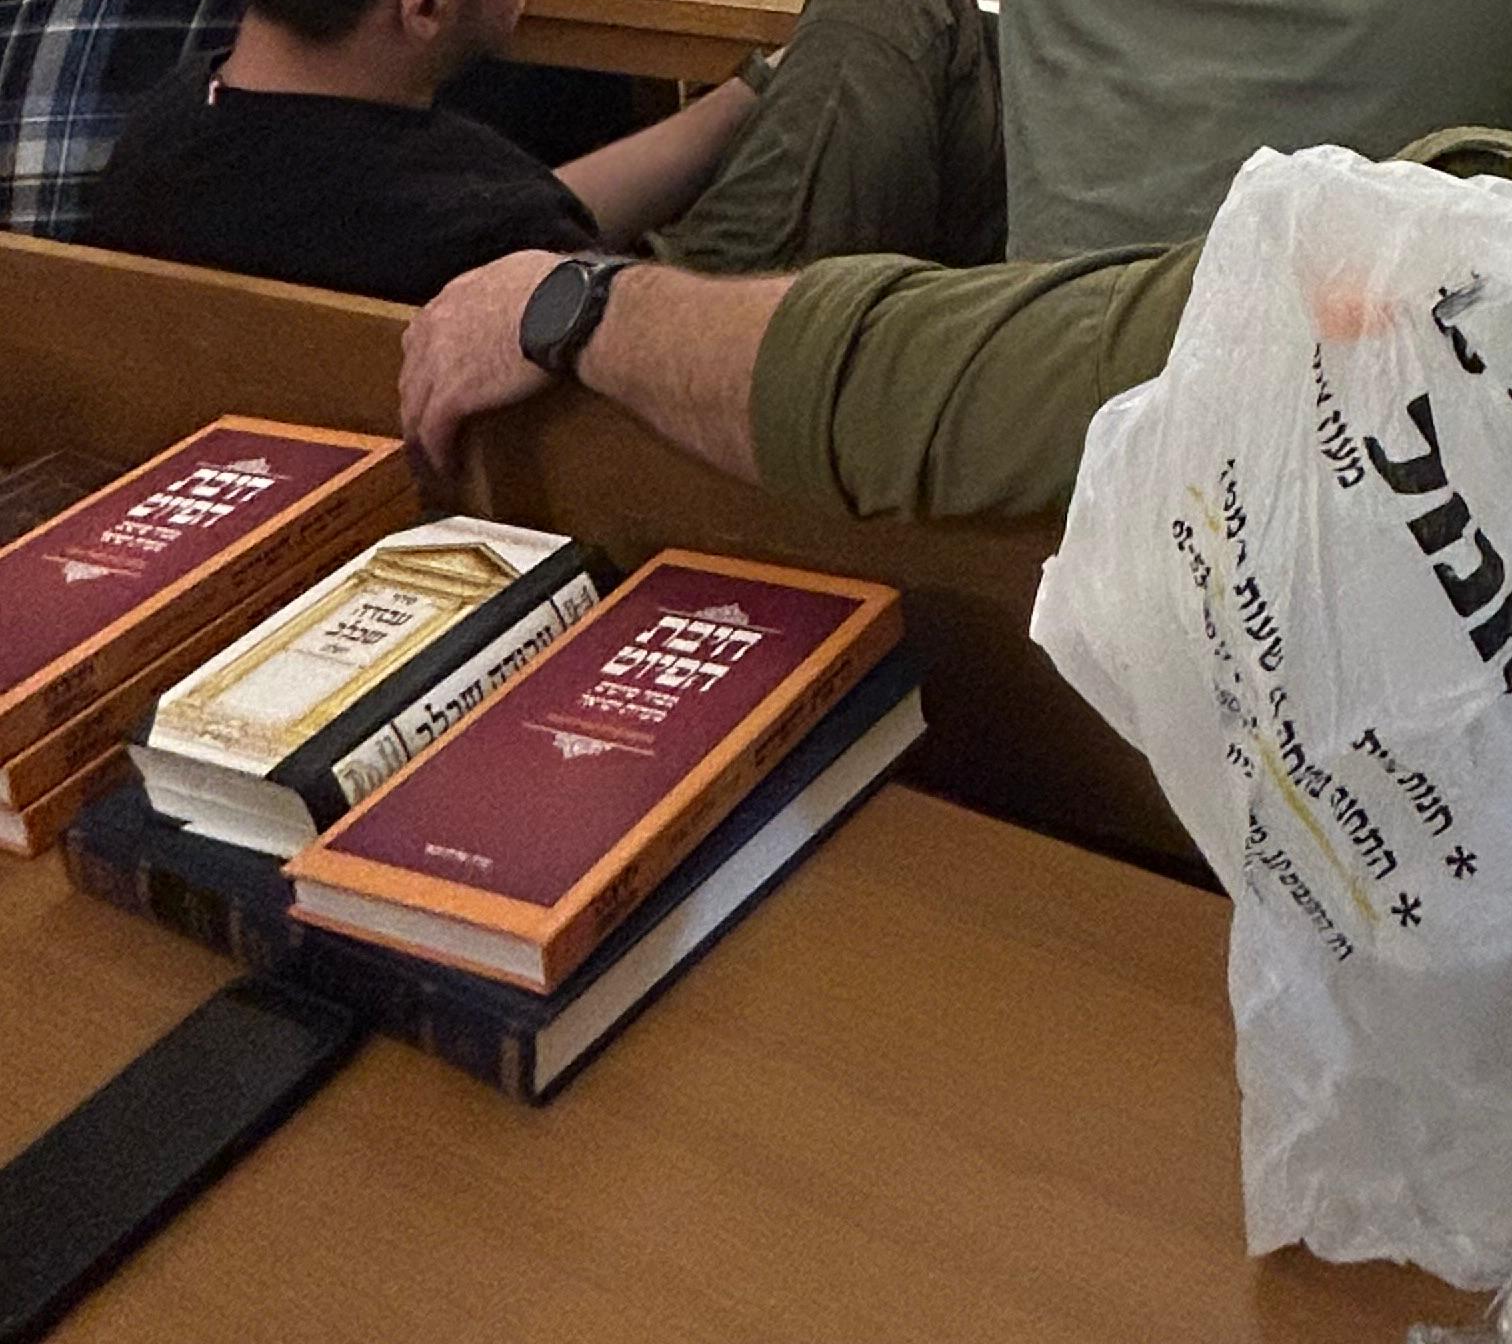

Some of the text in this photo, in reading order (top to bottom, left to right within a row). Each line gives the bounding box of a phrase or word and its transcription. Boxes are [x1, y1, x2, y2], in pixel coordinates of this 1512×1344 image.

[1316, 409, 1366, 489] מעוז
[1233, 575, 1284, 673] שעות
[1397, 771, 1454, 837] חנות
